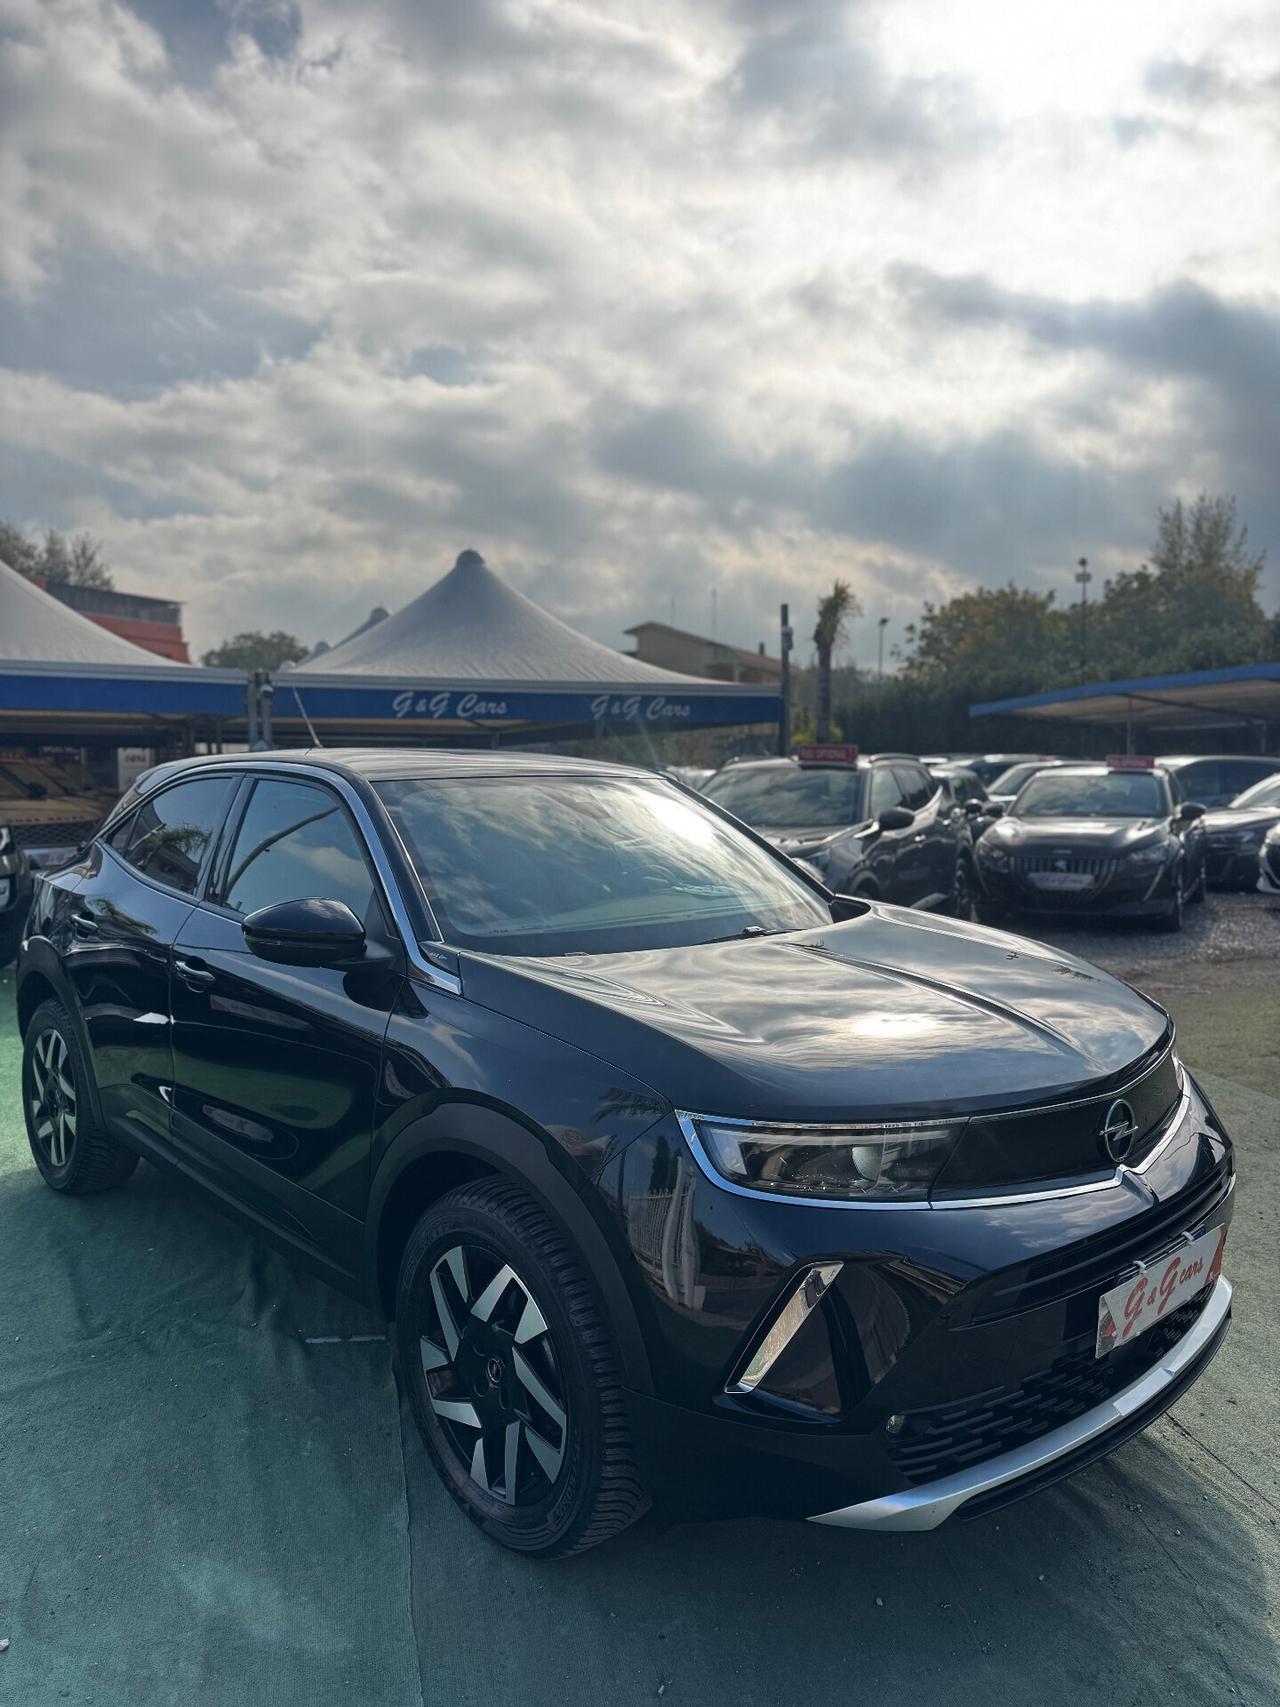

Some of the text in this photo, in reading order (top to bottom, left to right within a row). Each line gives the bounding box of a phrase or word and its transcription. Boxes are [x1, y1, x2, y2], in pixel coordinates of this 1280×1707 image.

[456, 693, 508, 718] Cars
[646, 696, 691, 720] Cars
[1180, 1258, 1204, 1285] cars
